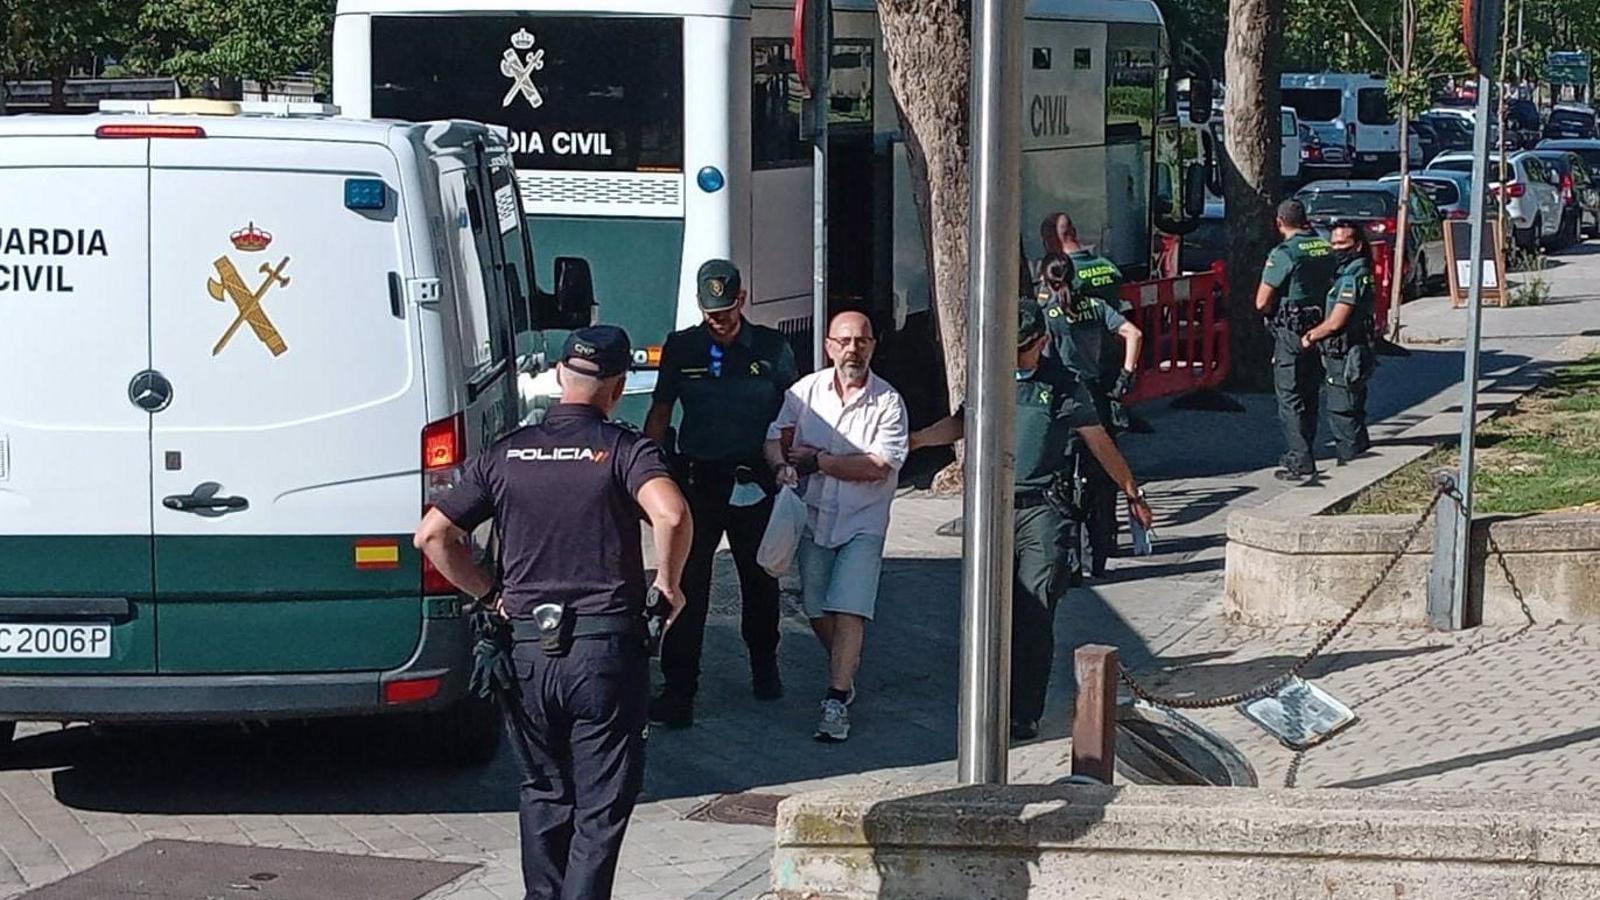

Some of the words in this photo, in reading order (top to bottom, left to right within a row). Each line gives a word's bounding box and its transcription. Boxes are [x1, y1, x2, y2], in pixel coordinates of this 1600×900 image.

[1030, 94, 1070, 137] CIVIL
[552, 131, 612, 155] CIVIL
[0, 227, 109, 256] ARDIA
[1078, 265, 1115, 279] GUARDIA
[1091, 276, 1114, 287] CIVIL
[574, 343, 595, 355] CNP
[506, 448, 594, 460] POLICIA
